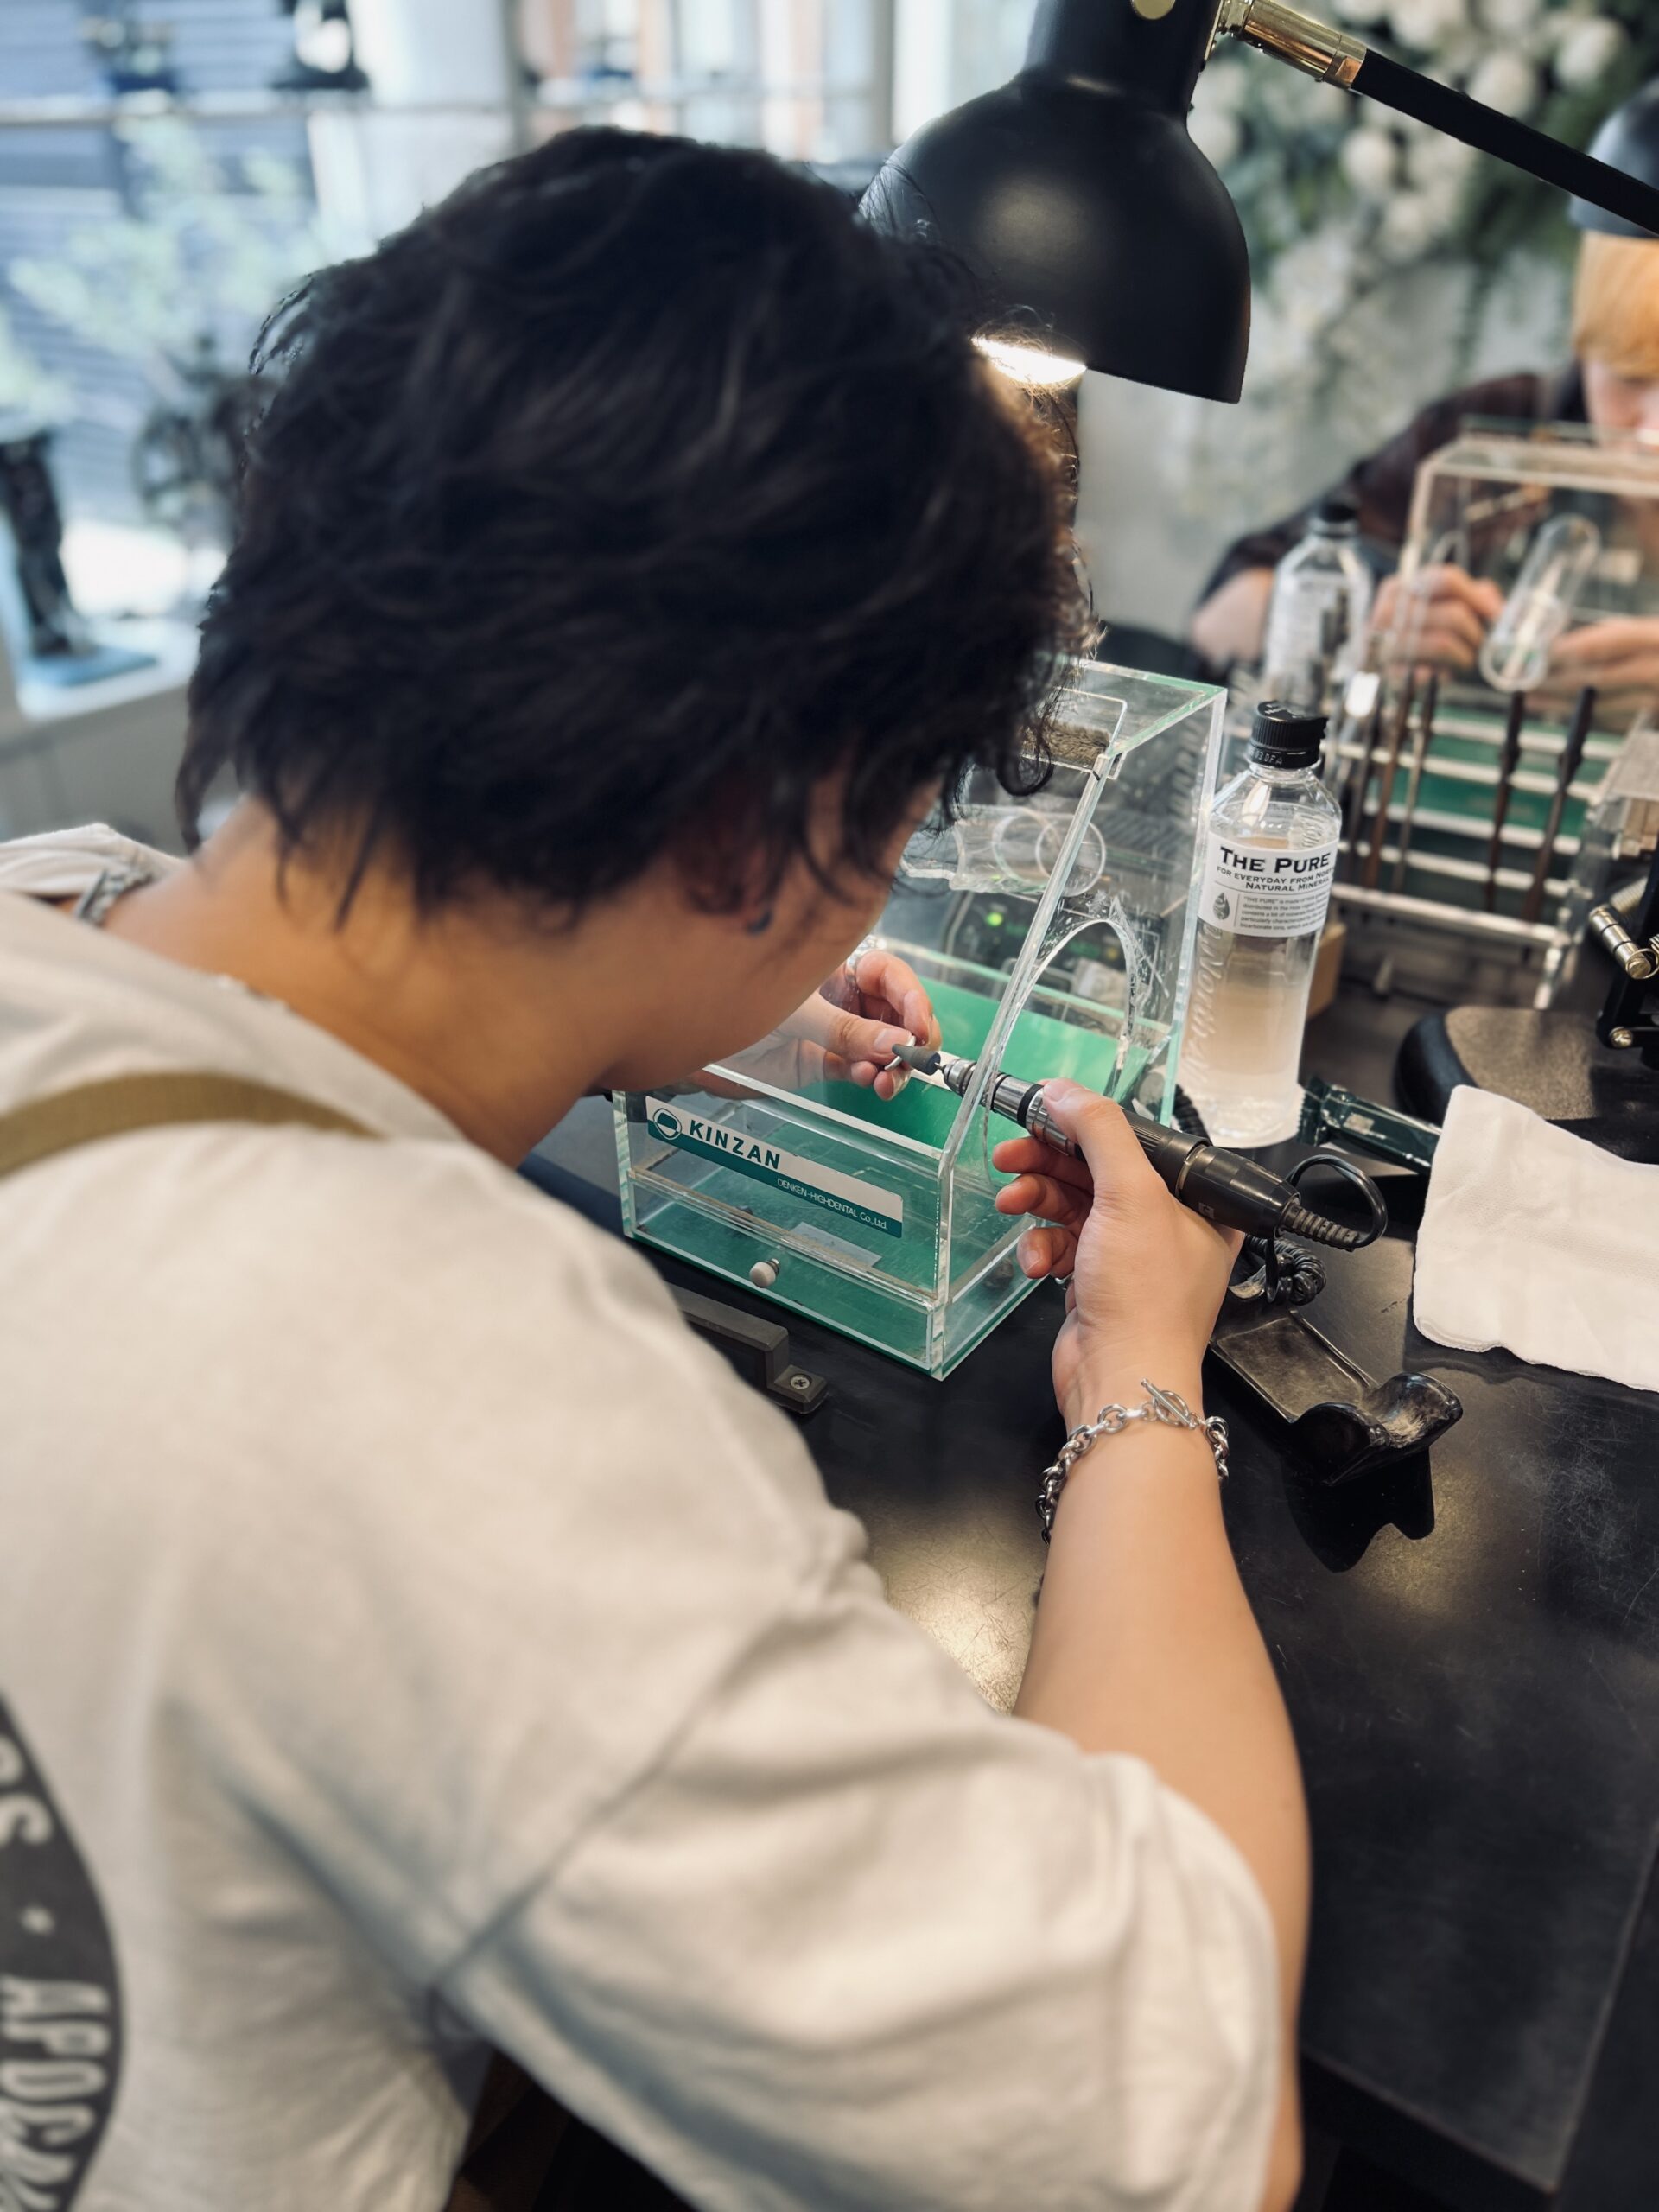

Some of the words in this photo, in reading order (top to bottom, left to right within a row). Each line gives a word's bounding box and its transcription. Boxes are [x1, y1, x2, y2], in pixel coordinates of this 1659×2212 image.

[1220, 846, 1266, 873] THE
[1274, 852, 1332, 874] PURE
[1217, 866, 1231, 877] FOR
[1234, 873, 1287, 884] EVERYDAY
[1290, 874, 1313, 884] FROM
[1245, 882, 1294, 892] NATURAL
[1298, 877, 1330, 891] MINERAL
[690, 1119, 780, 1170] KINZAN
